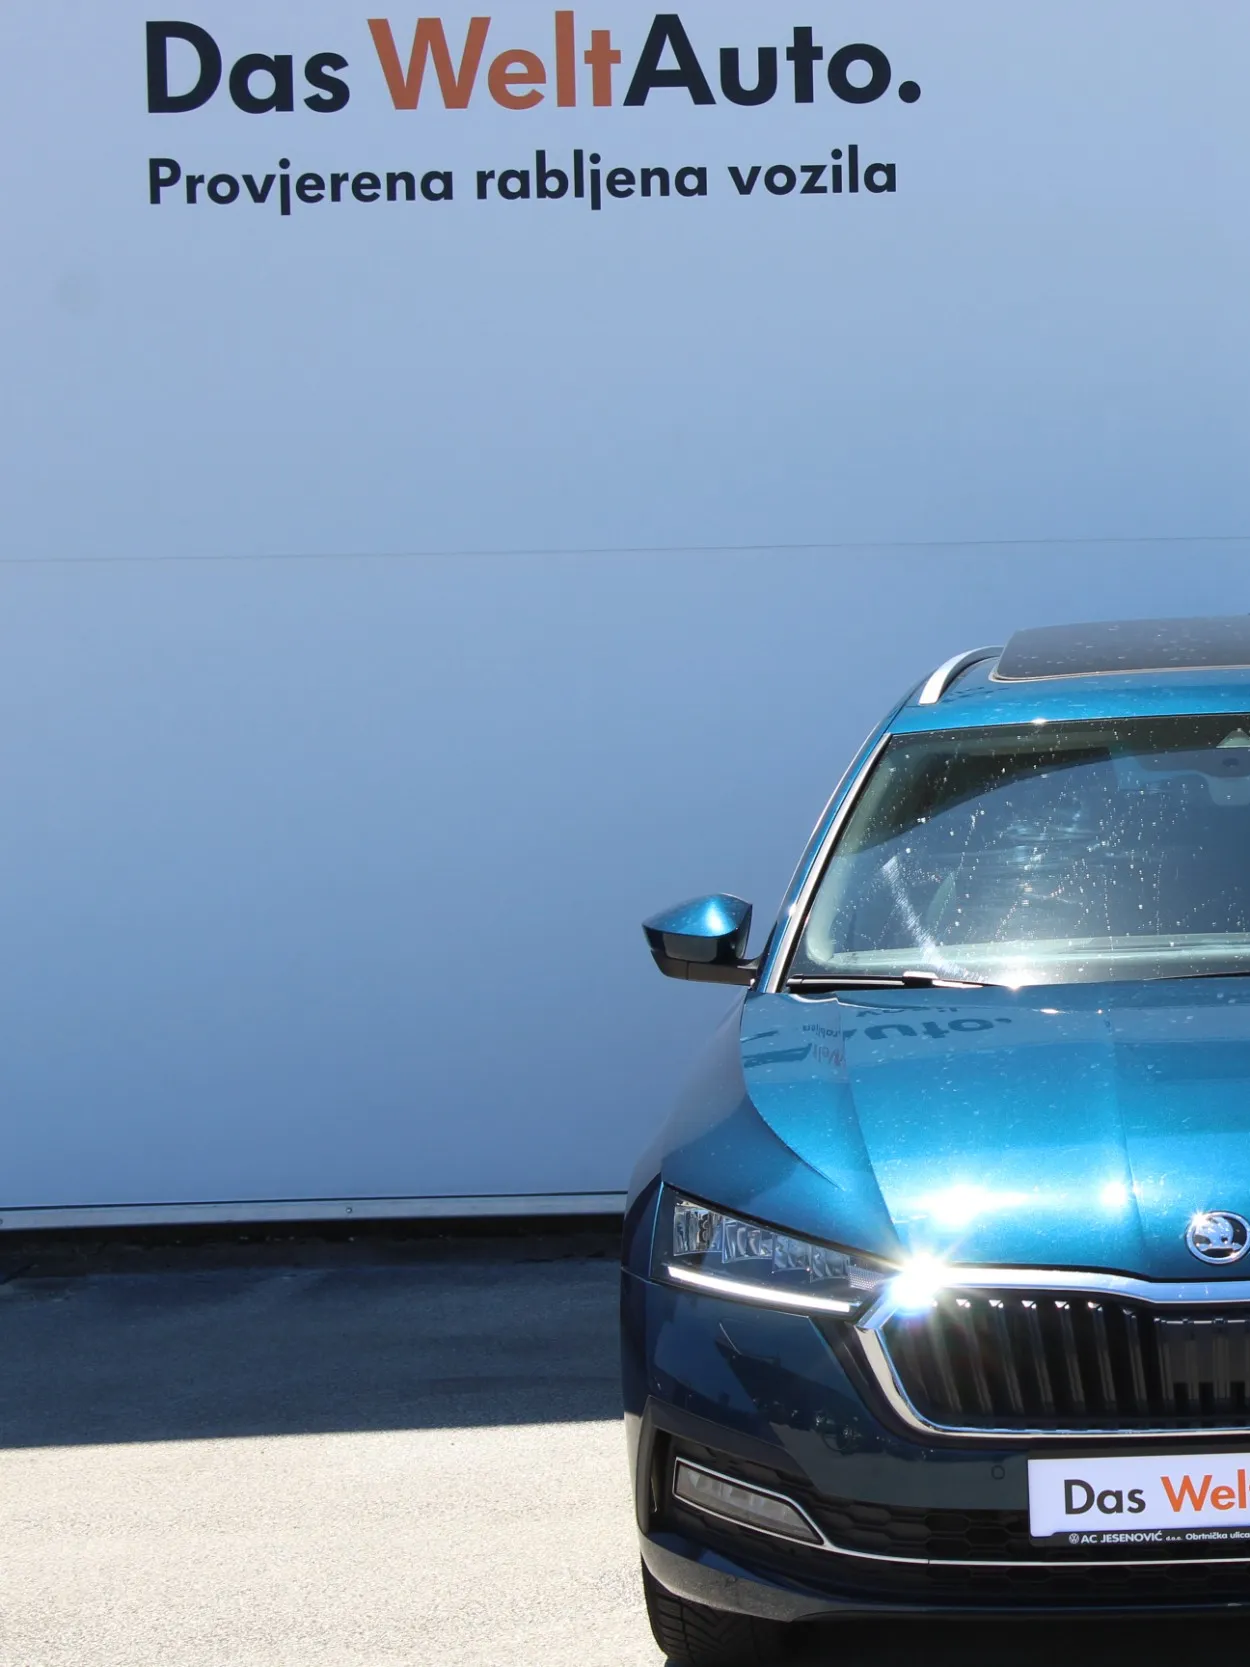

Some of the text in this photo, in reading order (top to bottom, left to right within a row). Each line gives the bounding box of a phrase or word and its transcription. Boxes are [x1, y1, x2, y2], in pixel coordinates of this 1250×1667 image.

[146, 10, 922, 115] Das WeltAuto.
[148, 144, 897, 216] Provjerena rabljena vozila
[1064, 1479, 1146, 1515] Das
[1081, 1534, 1097, 1544] AC
[1101, 1530, 1163, 1543] JESENOVIĆ
[1185, 1531, 1228, 1541] Obrtnička
[1230, 1529, 1250, 1539] ulica
